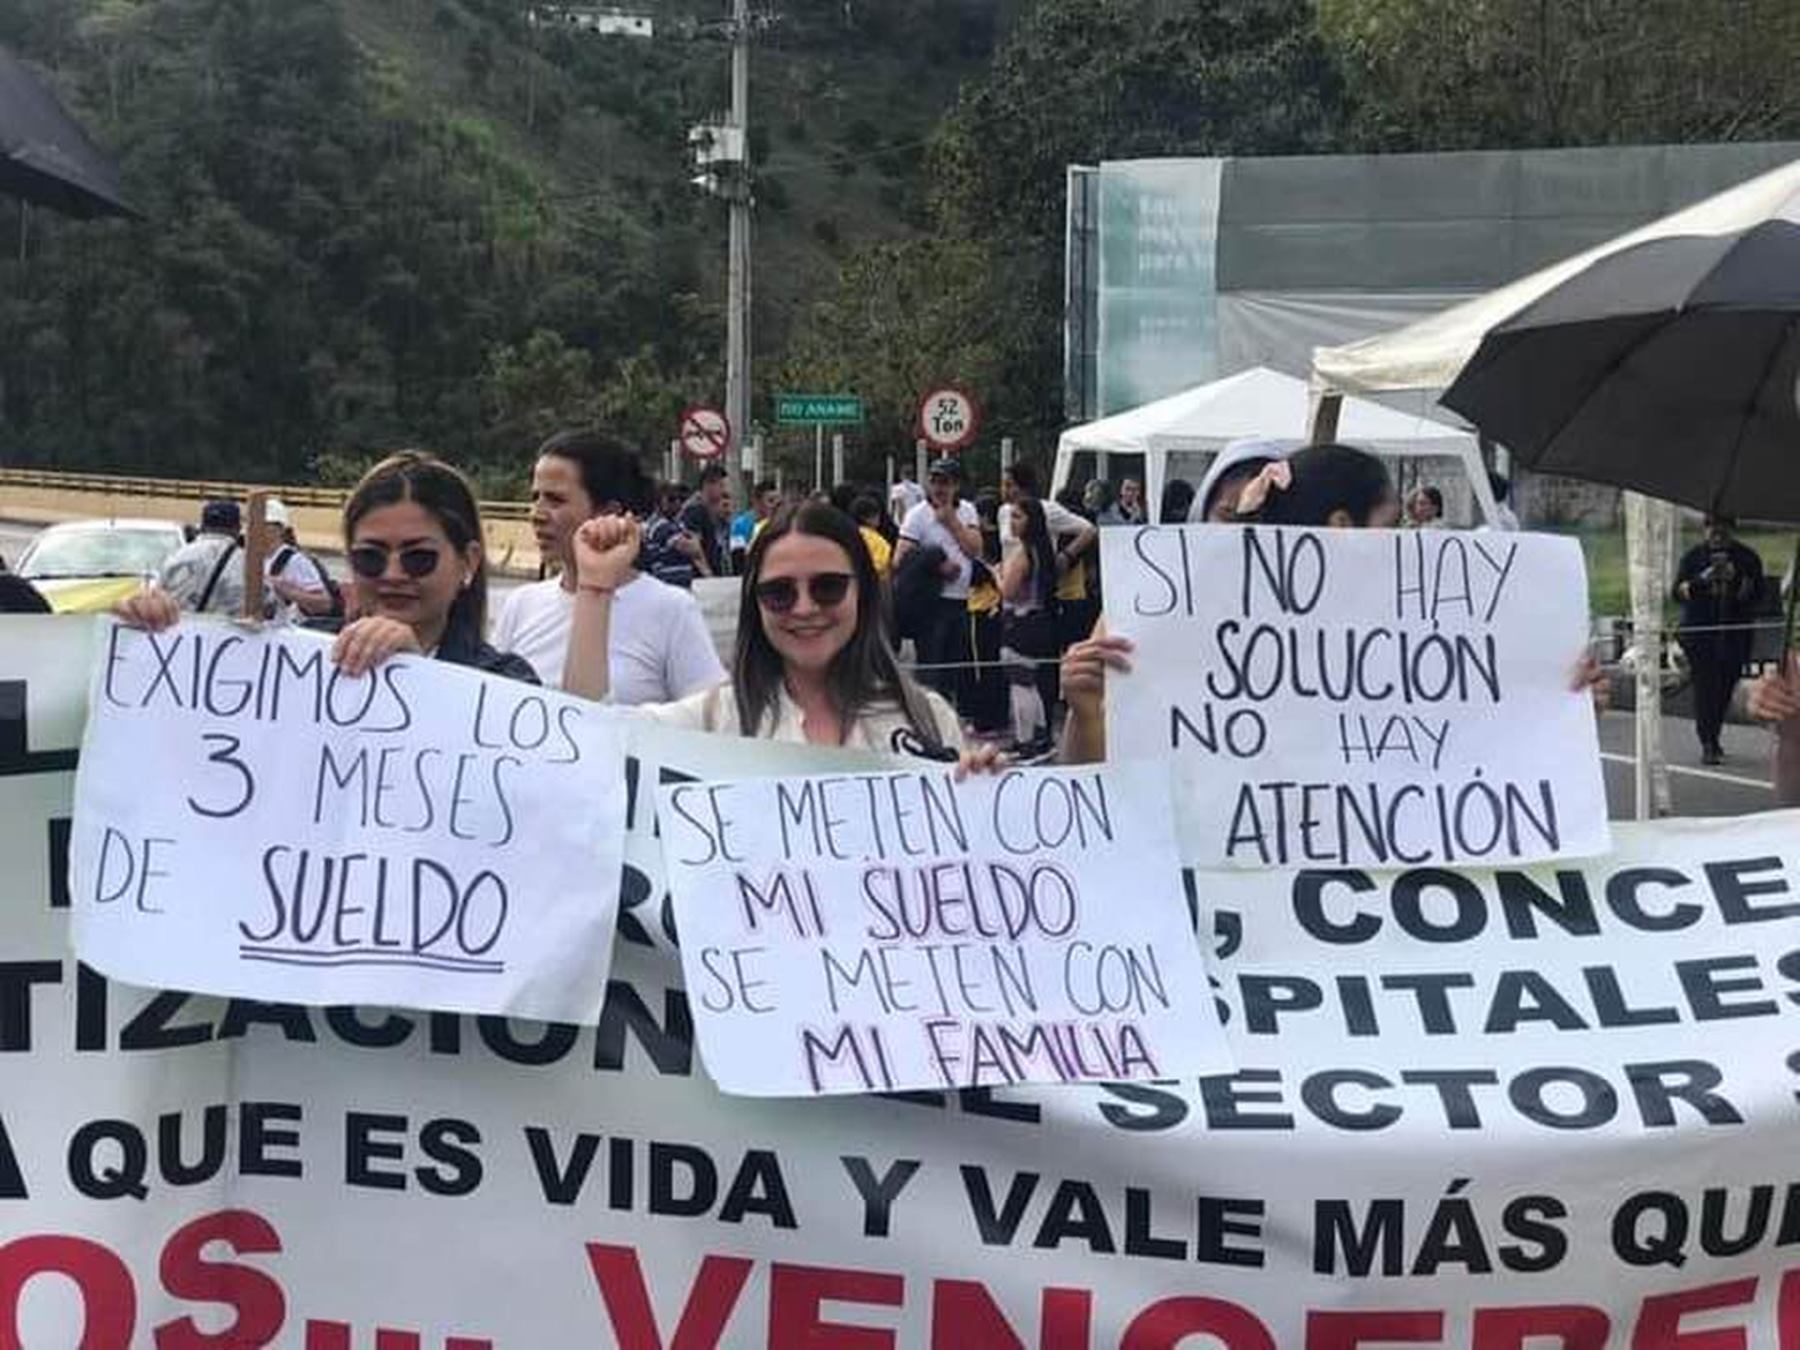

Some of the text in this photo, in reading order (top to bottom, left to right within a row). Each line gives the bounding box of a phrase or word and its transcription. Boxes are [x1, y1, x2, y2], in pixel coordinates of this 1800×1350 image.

[931, 416, 964, 434] Ton
[938, 398, 958, 417] 52
[1133, 526, 1517, 622] SI NO HAY
[104, 624, 411, 733] EXIGIMOS
[473, 682, 585, 763] LOS
[1206, 619, 1501, 702] SOLUCIÓN
[1171, 704, 1450, 770] NO HAY
[187, 734, 255, 818] 3
[314, 744, 523, 847] MESES
[671, 783, 745, 866] SE
[777, 773, 970, 862] METEN
[993, 771, 1114, 855] CON
[1225, 767, 1561, 864] ATENCIÓN
[94, 828, 178, 914] DE
[239, 846, 508, 956] SUELDO
[736, 869, 824, 938] MI
[862, 862, 1076, 940] SUELDO
[700, 942, 1170, 1018] SE METEN CON
[1208, 950, 1800, 1036] PITALE
[802, 1020, 1160, 1093] MI FAMILIA
[1098, 1059, 1745, 1131] SECTOR
[67, 1102, 303, 1200] QUE
[346, 1112, 483, 1196] ES
[524, 1126, 799, 1230] VIDA
[840, 1156, 921, 1238] Y
[959, 1164, 1266, 1269] VALE
[1312, 1178, 1569, 1278] MÁS
